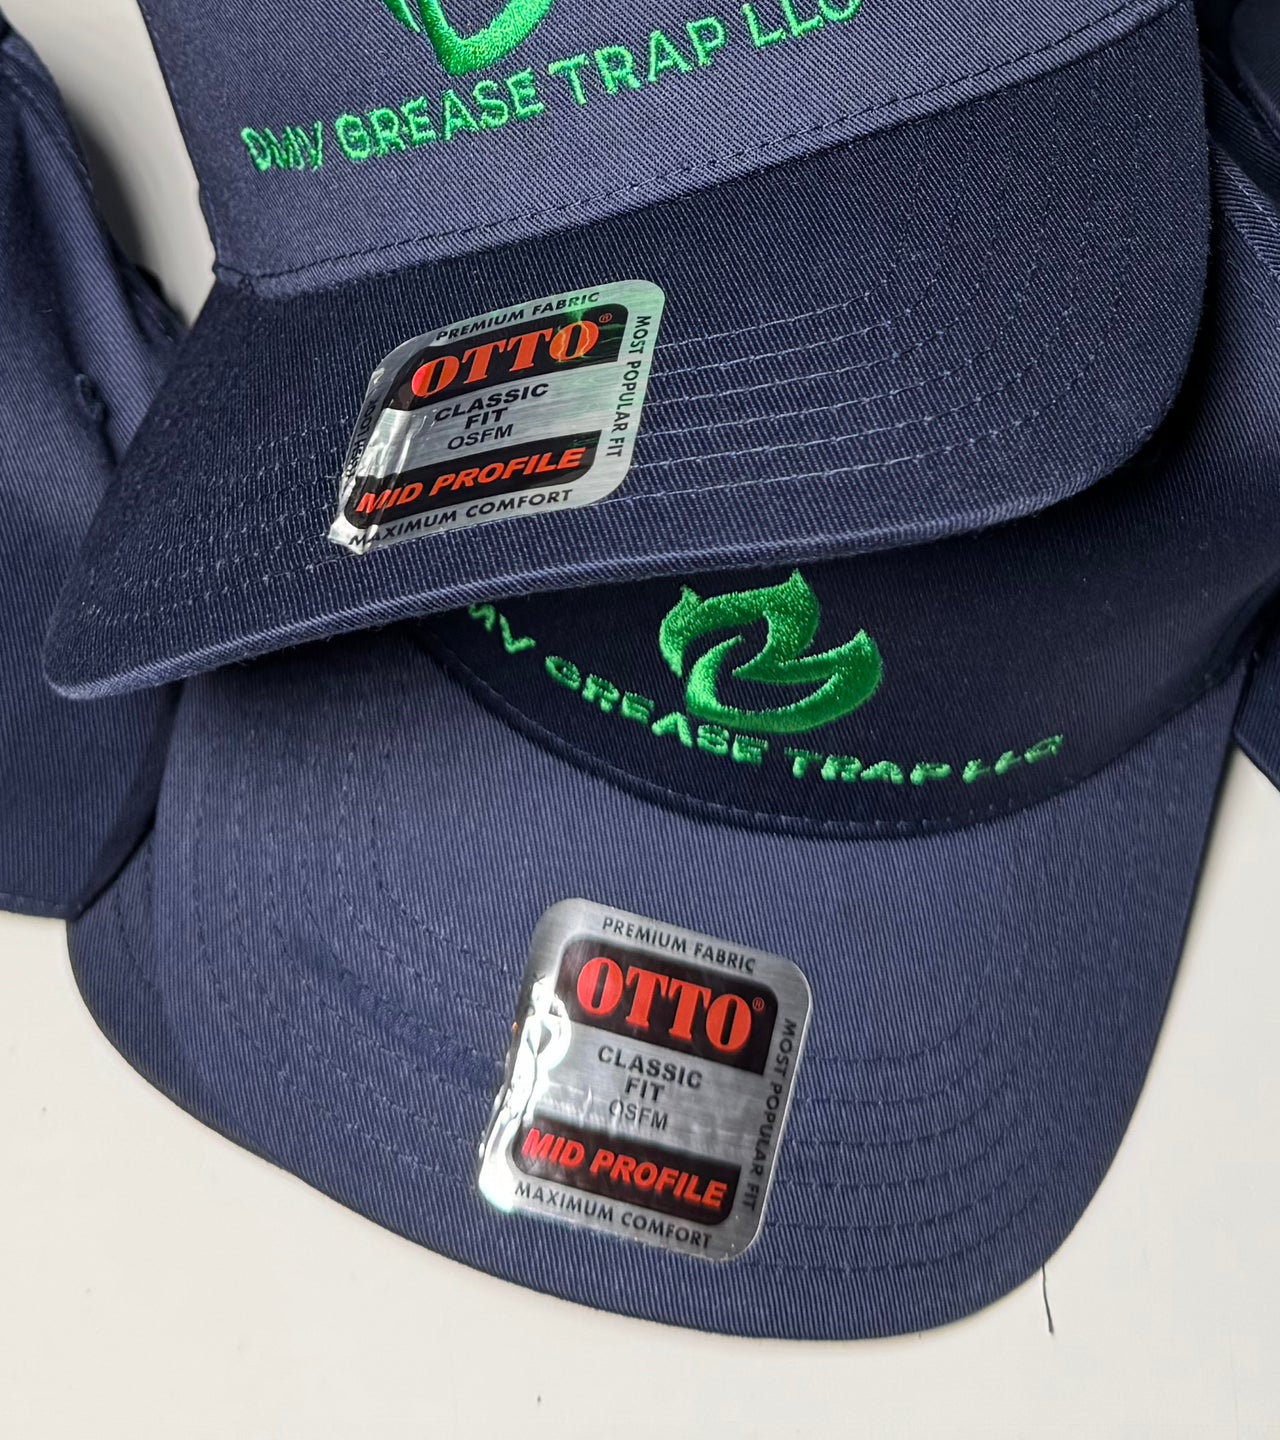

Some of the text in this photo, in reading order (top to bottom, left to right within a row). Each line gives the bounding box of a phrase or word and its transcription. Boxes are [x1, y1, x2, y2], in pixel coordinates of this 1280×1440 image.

[241, 120, 323, 172] DMV
[334, 68, 545, 161] GREASE
[549, 15, 730, 104] TRAP
[436, 291, 601, 342] PREMIUM FABRIC
[411, 320, 600, 398] OTTO
[606, 314, 652, 458] MOST POPULAR FIT
[433, 382, 550, 423] CLASSIC
[464, 407, 509, 430] FIT
[446, 423, 514, 451] OSFM
[355, 446, 587, 514] MID PROFILE
[348, 488, 574, 548] MAXIMUM COMFORT
[545, 655, 769, 763] GREASE
[783, 745, 951, 784] TRAP
[601, 916, 756, 975] PREMIUM FABRIC
[576, 956, 753, 1053] OTTO
[597, 1044, 703, 1090] CLASSIC
[624, 1076, 666, 1102] FIT
[608, 1098, 668, 1131] OSFM
[741, 1017, 798, 1211] MOST POPULAR FIT
[521, 1126, 728, 1208] MID PROFILE
[513, 1182, 712, 1250] MAXIMUM COMFORT
